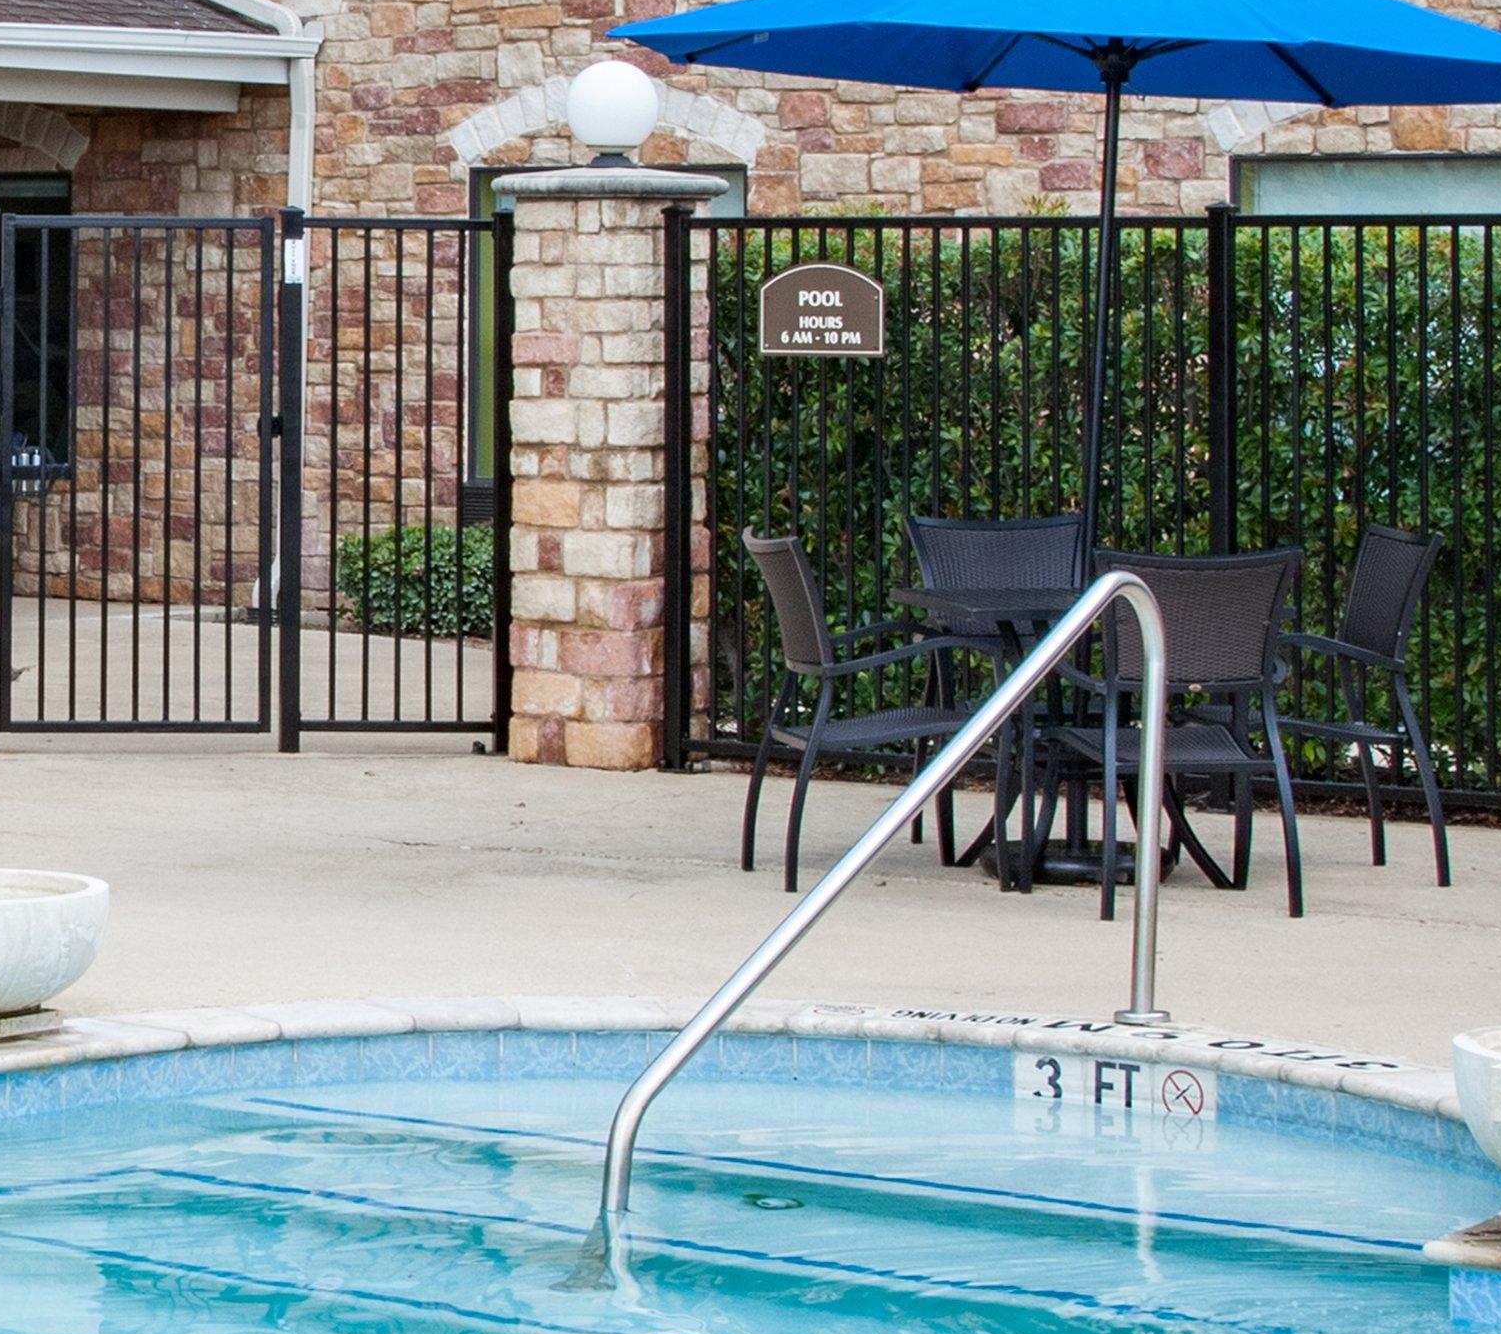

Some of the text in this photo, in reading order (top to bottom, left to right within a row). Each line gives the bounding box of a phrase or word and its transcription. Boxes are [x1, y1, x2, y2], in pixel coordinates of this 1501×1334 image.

[799, 291, 843, 307] POOL
[799, 316, 843, 329] HOURS
[781, 331, 789, 343] 6
[792, 331, 812, 344] AM
[824, 331, 837, 344] 10
[841, 331, 861, 344] PM
[1034, 1056, 1141, 1108] 3 FT
